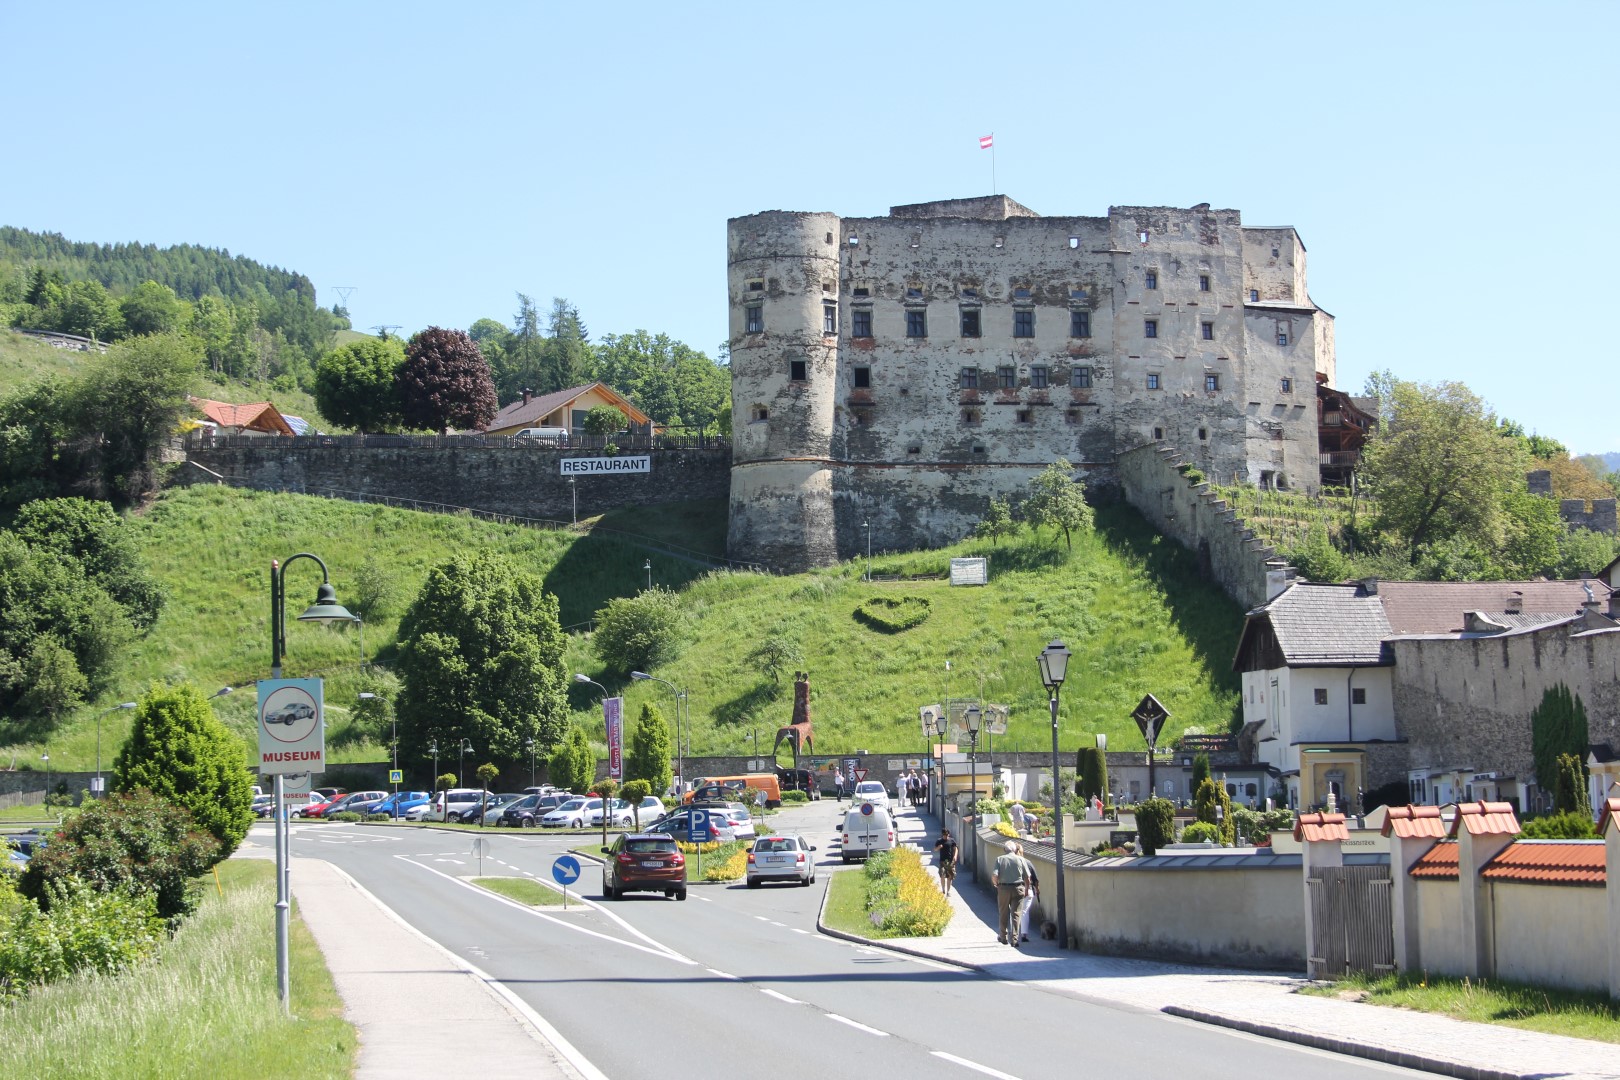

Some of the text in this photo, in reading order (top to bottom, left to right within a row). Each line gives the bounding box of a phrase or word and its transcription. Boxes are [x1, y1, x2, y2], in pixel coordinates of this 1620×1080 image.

[563, 459, 647, 472] RESTAURANT
[263, 750, 321, 762] MUSEUM
[691, 810, 706, 830] P
